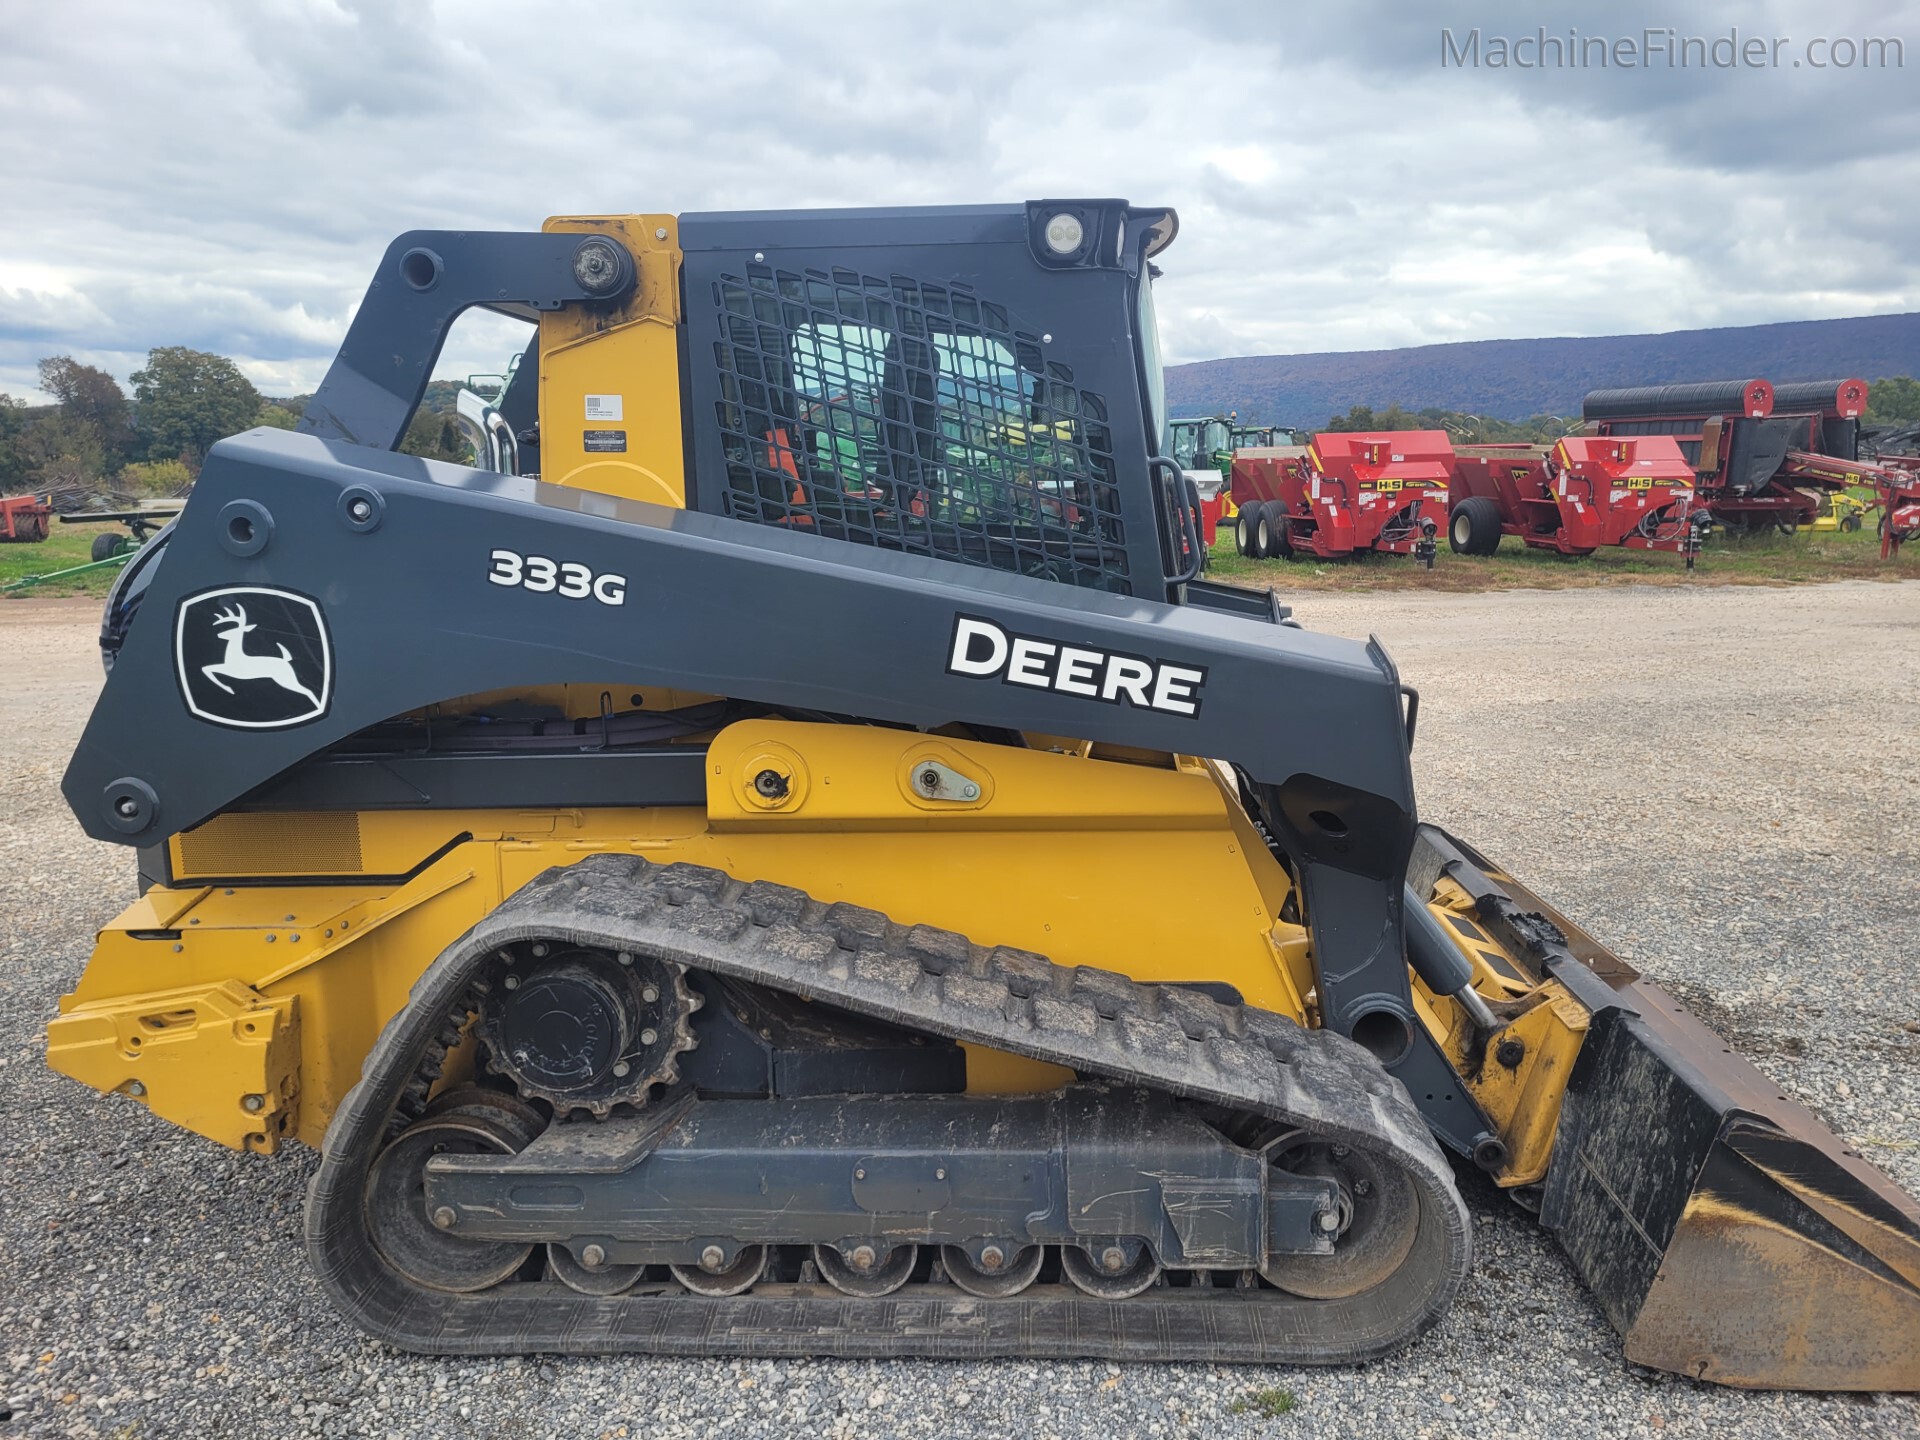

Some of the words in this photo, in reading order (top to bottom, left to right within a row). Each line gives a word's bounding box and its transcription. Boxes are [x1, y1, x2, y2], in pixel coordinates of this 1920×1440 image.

[1379, 480, 1401, 489] H&S
[1629, 479, 1650, 488] H&S
[489, 550, 626, 605] 333G
[950, 618, 1202, 714] DEERE
